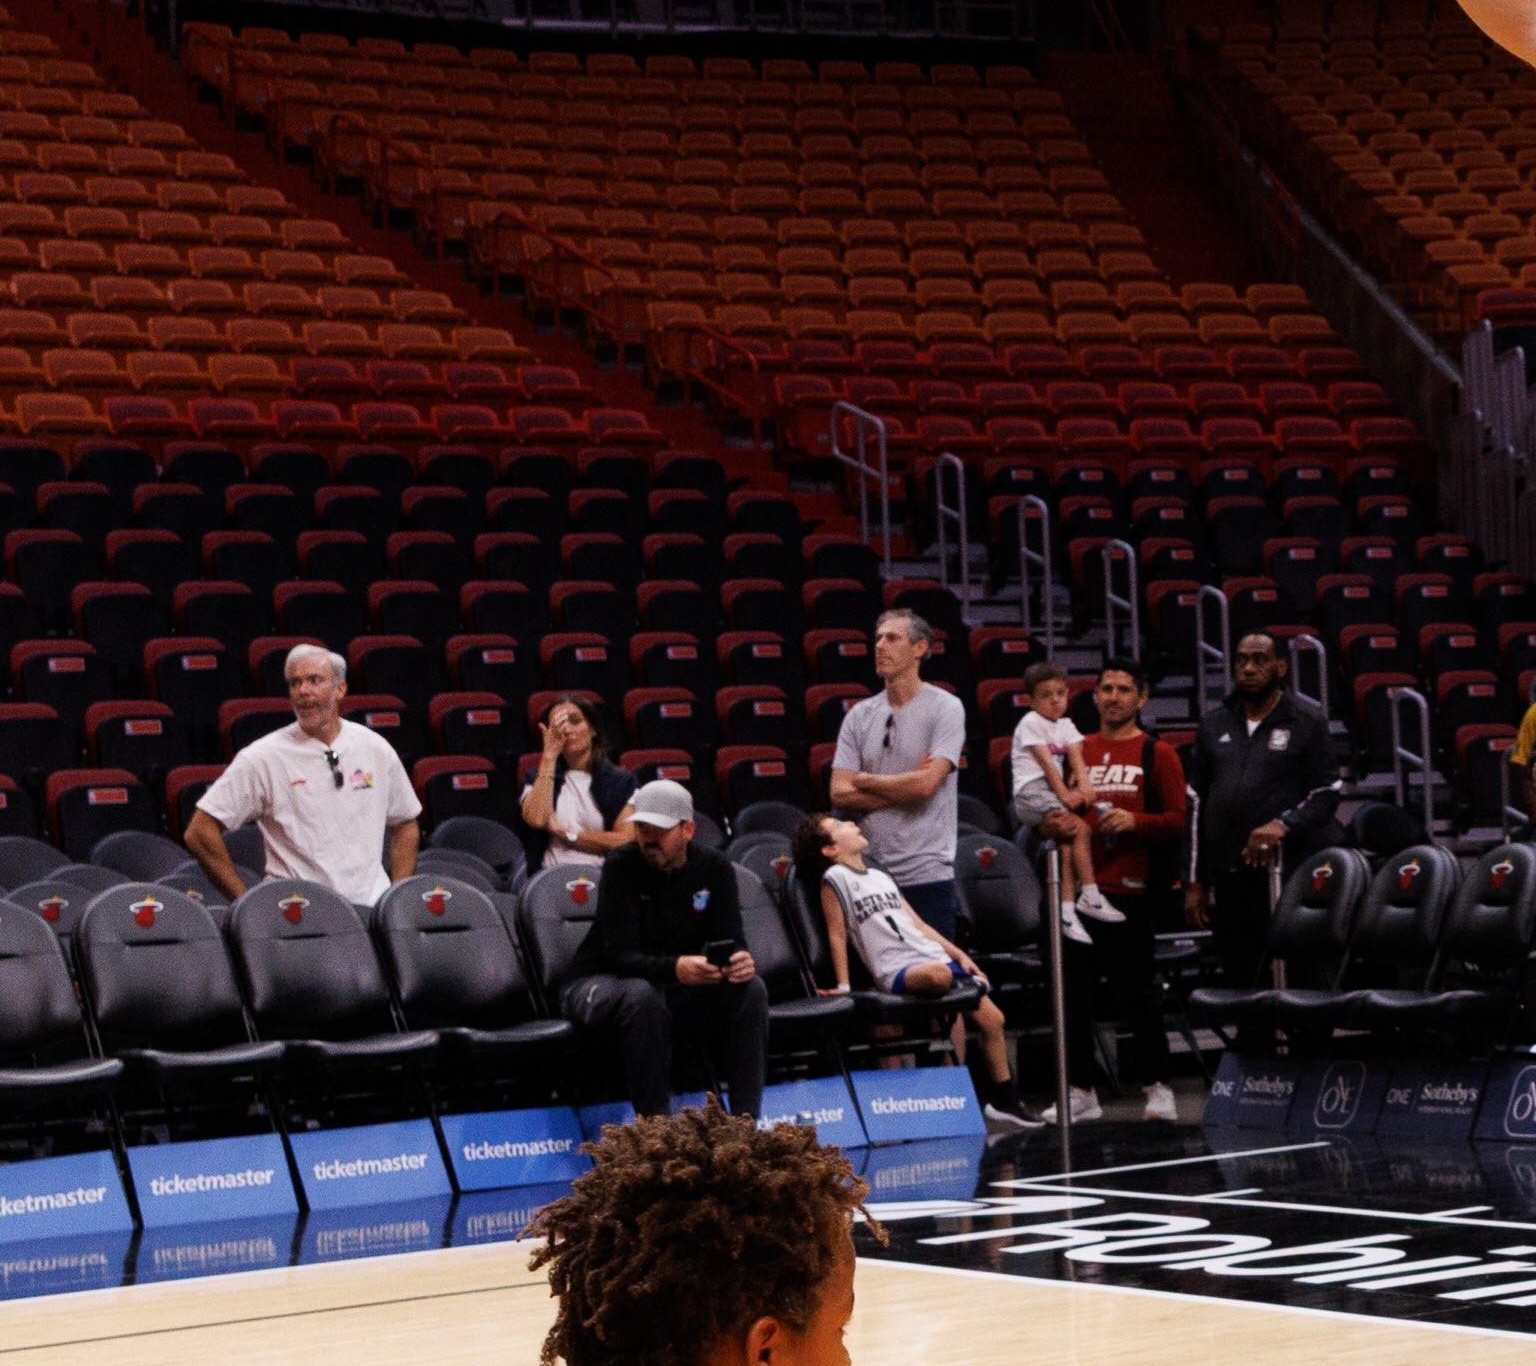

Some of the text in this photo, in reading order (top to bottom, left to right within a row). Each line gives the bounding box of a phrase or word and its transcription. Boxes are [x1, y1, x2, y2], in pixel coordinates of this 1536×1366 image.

[1087, 763, 1145, 785] EAT
[871, 1095, 966, 1115] ticketmaster
[463, 1137, 574, 1162] ticketmaster
[312, 1153, 429, 1182] ticketmaster
[150, 1168, 275, 1197] ticketmaster
[0, 1186, 108, 1217] ketmaster
